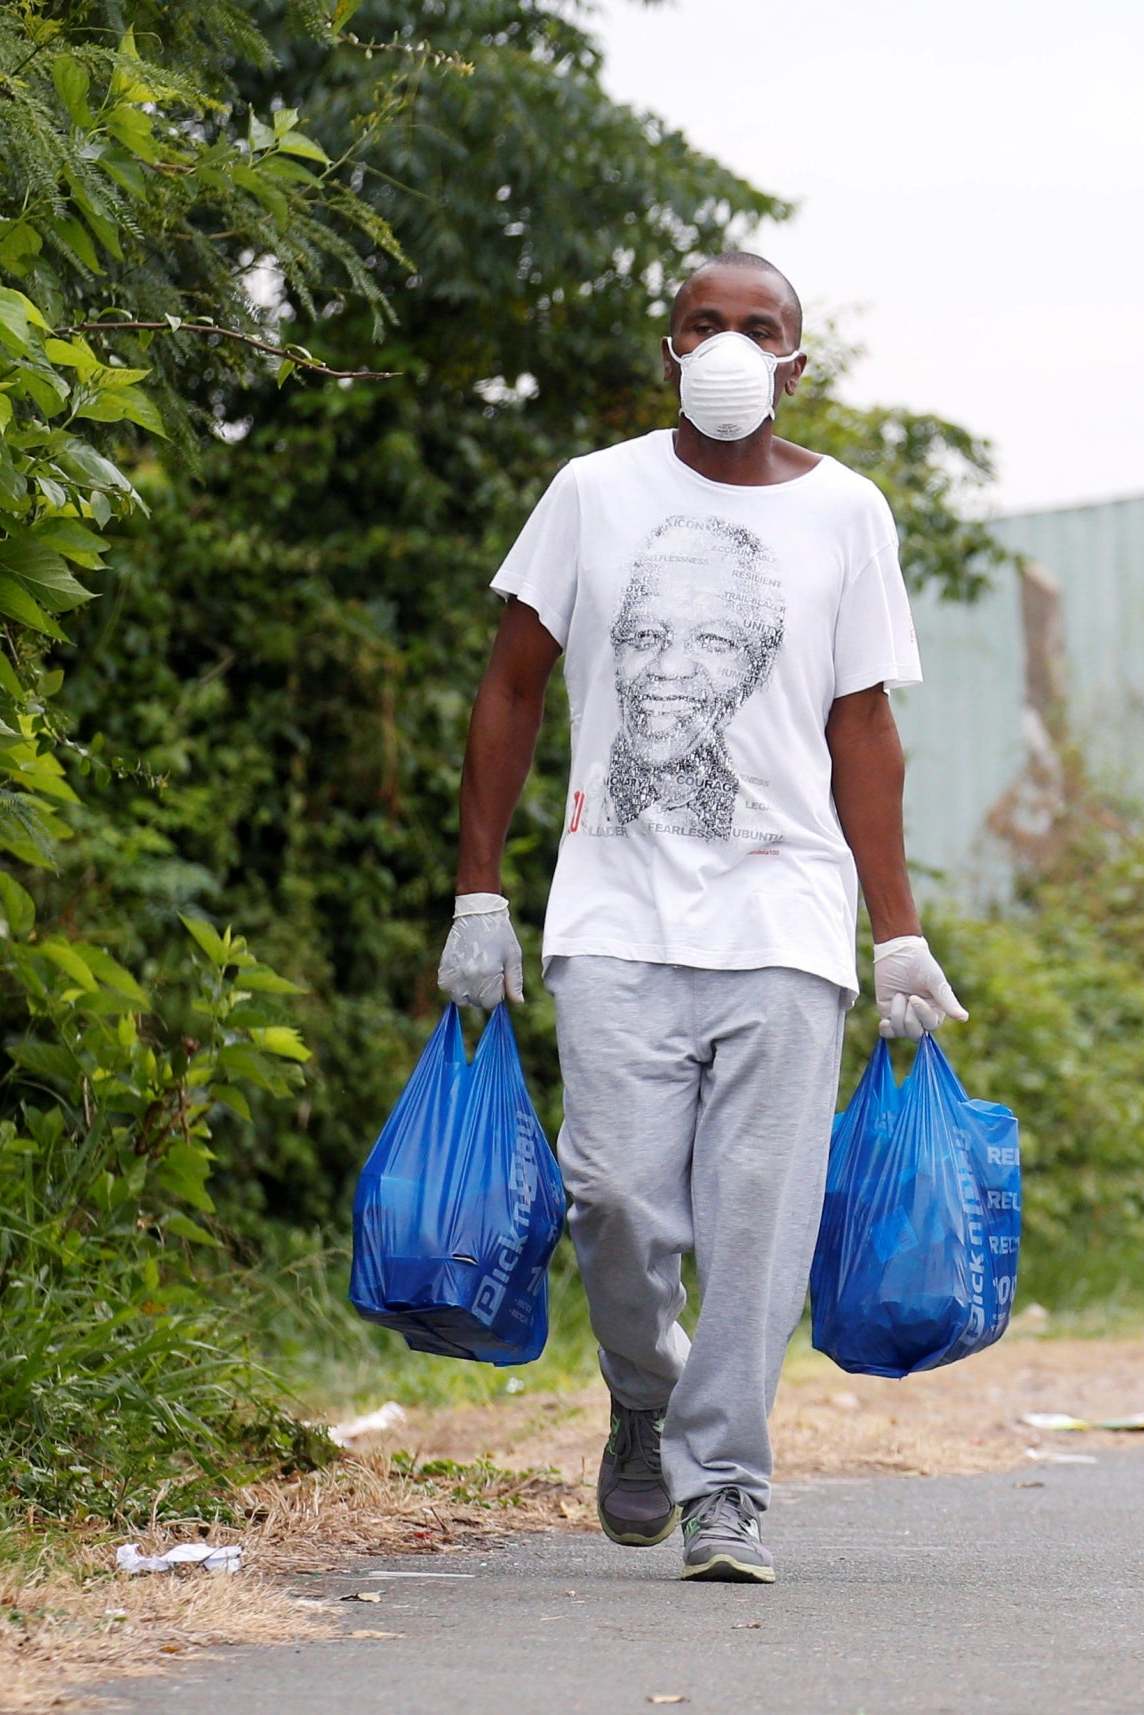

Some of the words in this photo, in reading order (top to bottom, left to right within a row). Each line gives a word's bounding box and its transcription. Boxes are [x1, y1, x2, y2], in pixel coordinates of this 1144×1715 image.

[675, 774, 739, 794] COURAGE
[648, 822, 714, 841] FEARLESS
[471, 1231, 530, 1326] Pick
[958, 1248, 986, 1346] Pick
